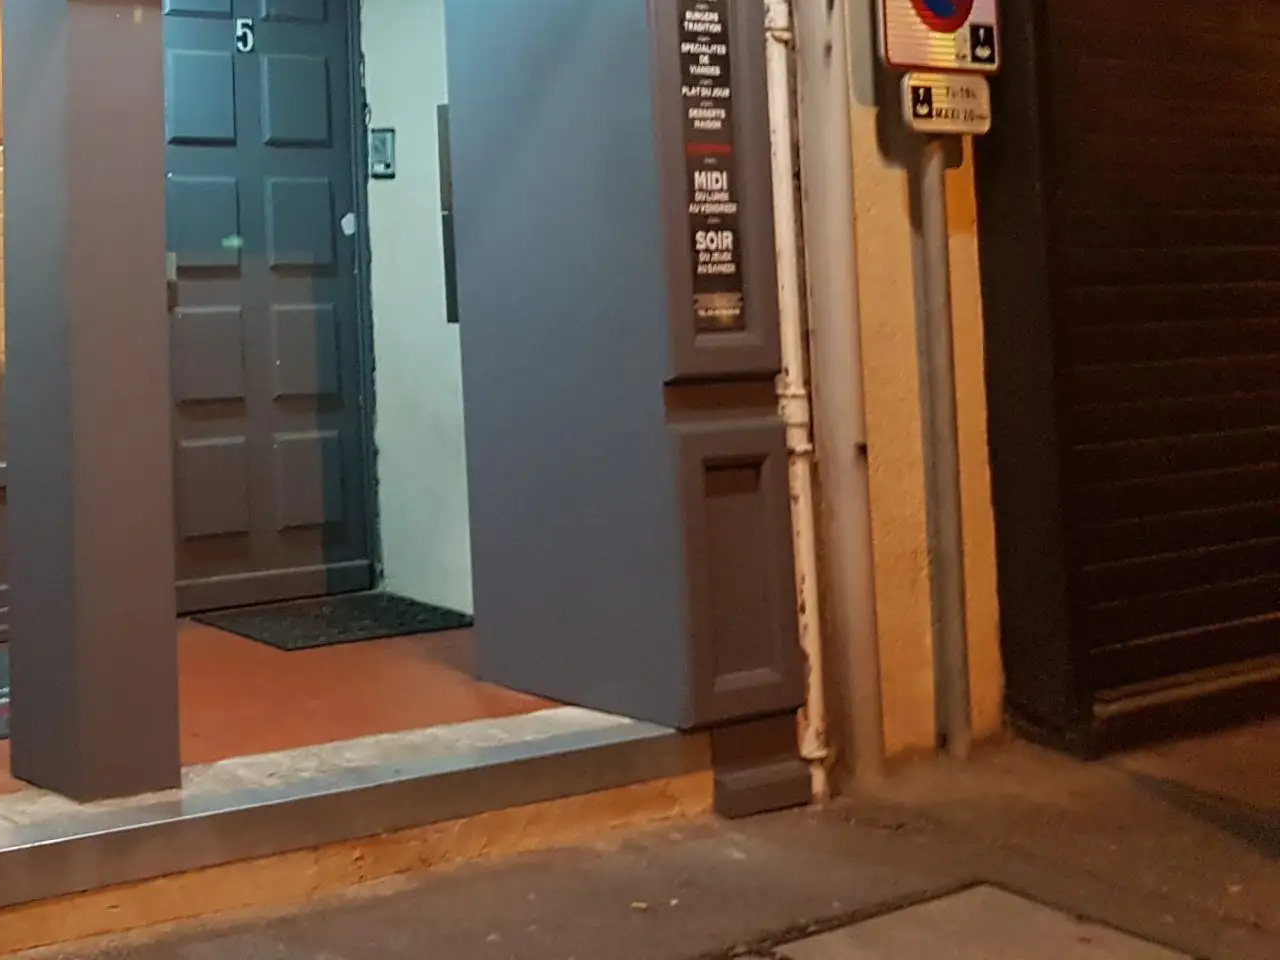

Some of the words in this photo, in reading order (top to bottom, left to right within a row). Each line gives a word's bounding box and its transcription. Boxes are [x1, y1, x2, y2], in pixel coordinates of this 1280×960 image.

[685, 10, 719, 22] BURGERS
[235, 17, 254, 52] 5
[681, 85, 700, 97] PLAT
[700, 86, 712, 97] DU
[712, 87, 730, 98] JOUR
[694, 170, 728, 190] MIDI
[695, 230, 733, 251] SOIR
